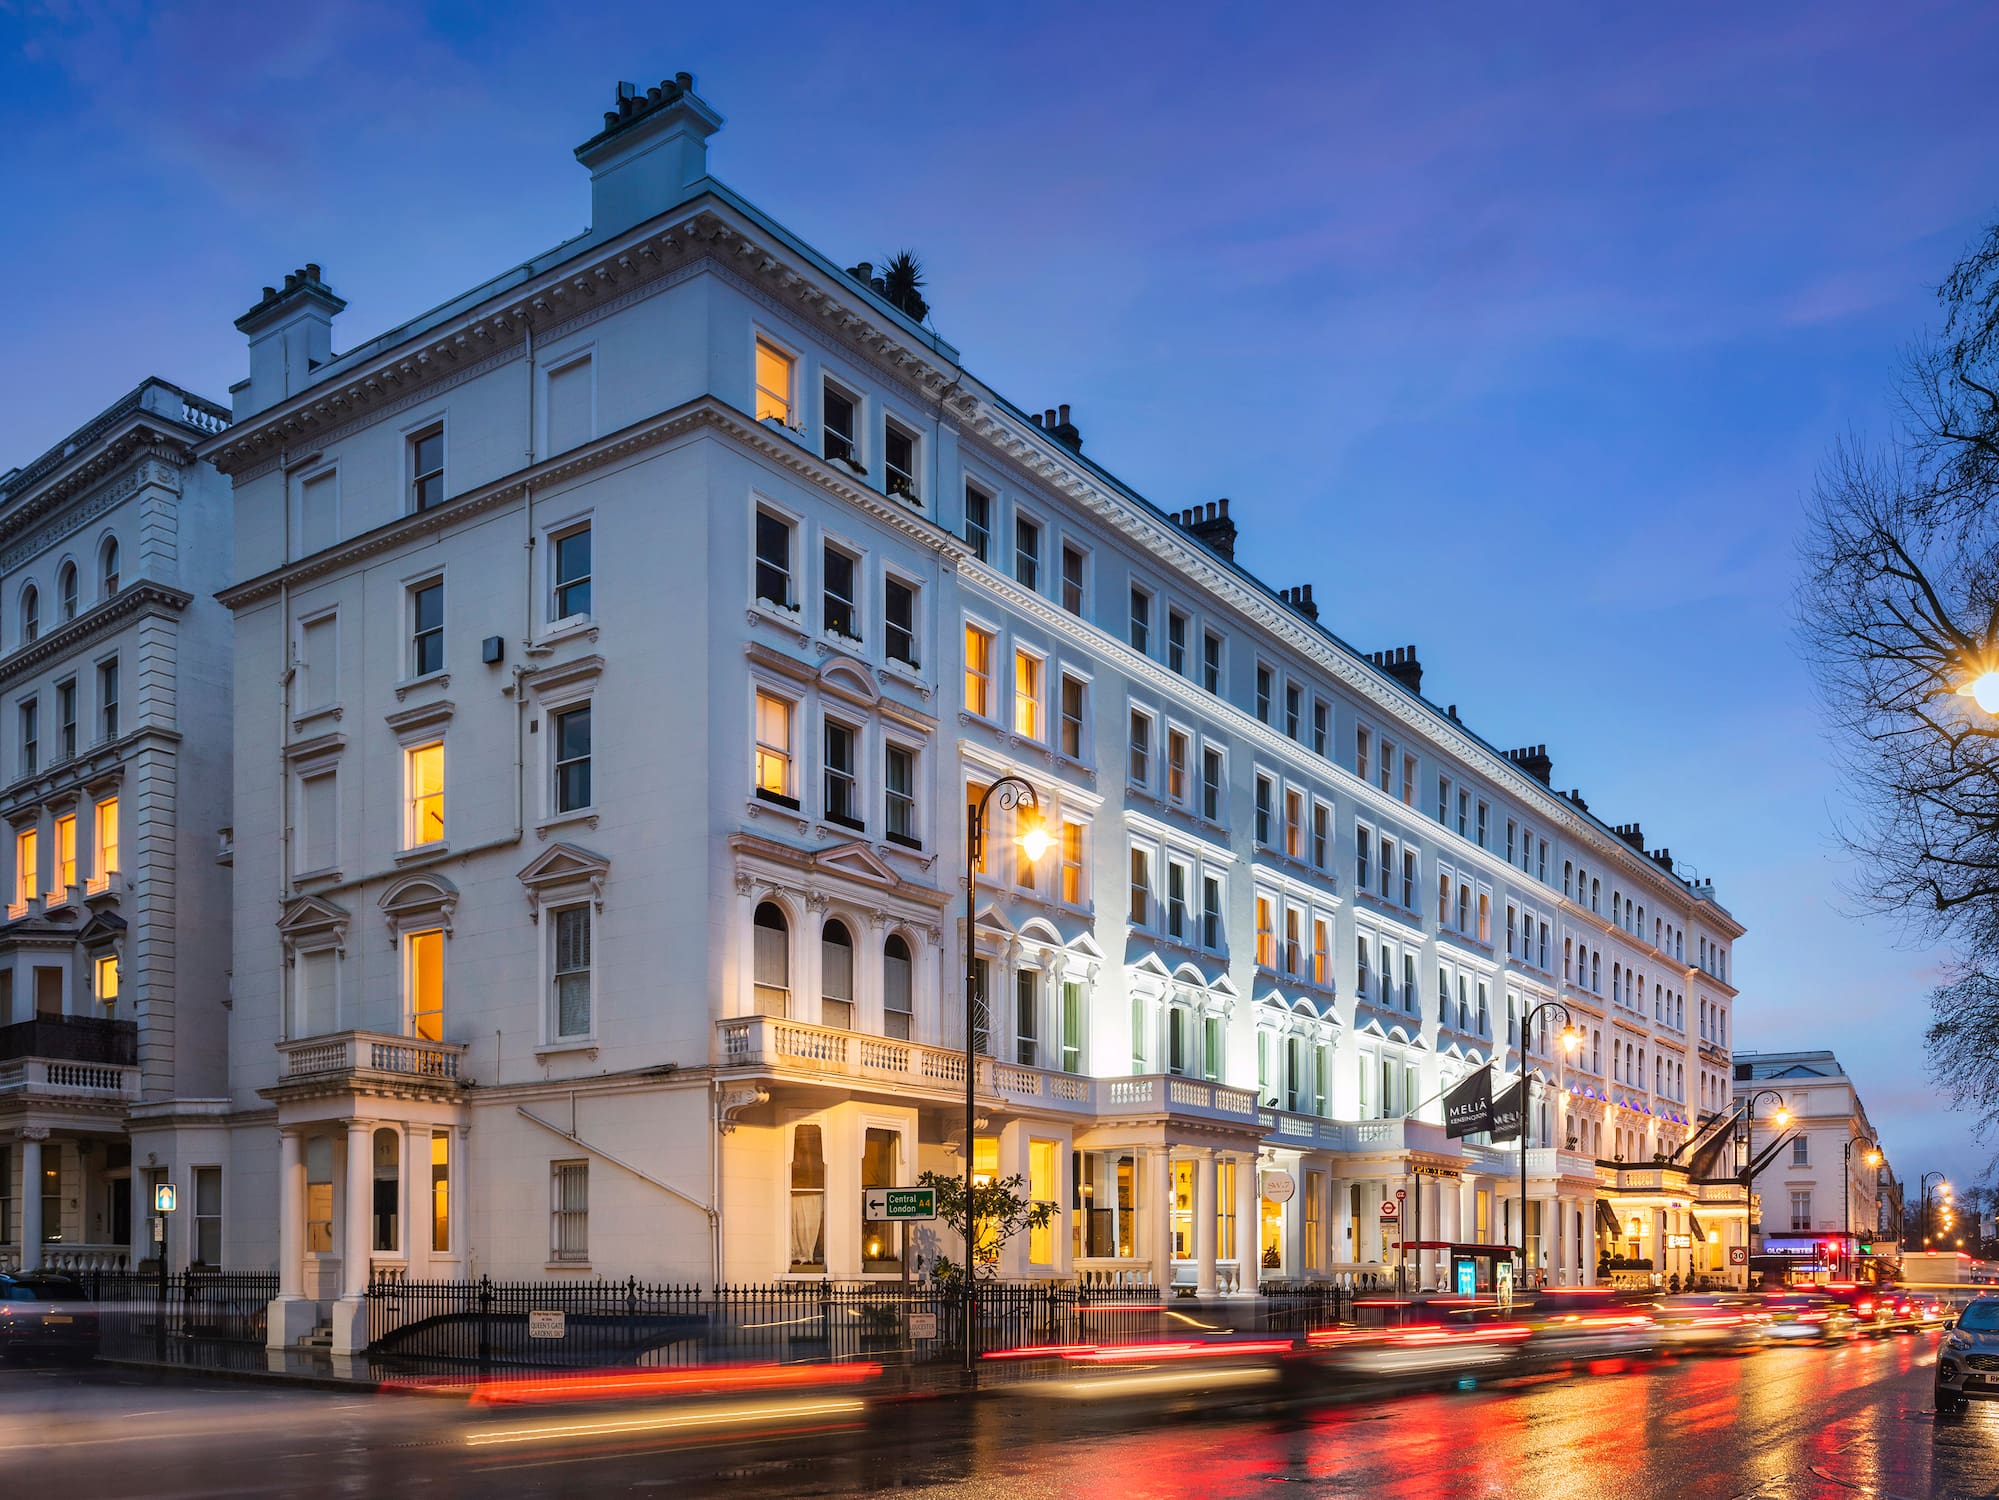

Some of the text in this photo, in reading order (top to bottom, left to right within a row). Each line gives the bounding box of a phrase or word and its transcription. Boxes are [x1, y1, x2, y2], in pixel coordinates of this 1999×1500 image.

[1493, 1111, 1519, 1125] MELI
[889, 1194, 917, 1203] Central
[918, 1199, 931, 1207] A4
[889, 1205, 917, 1213] London
